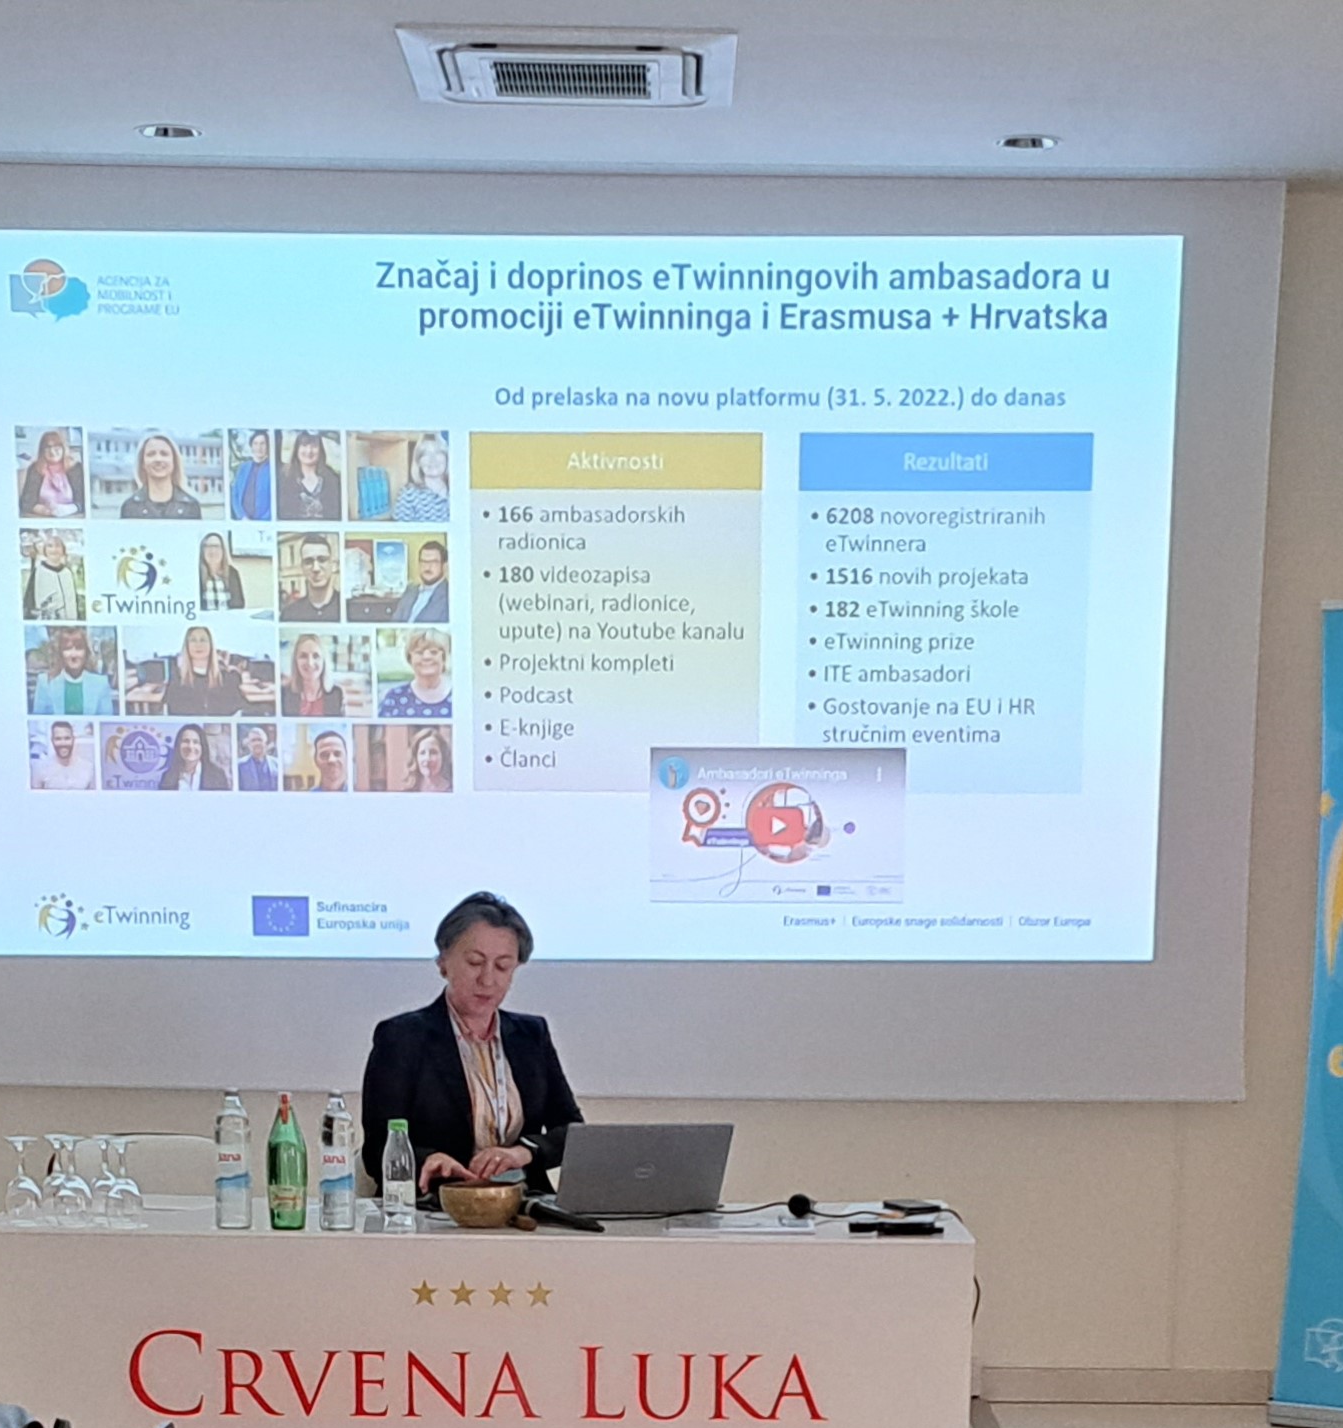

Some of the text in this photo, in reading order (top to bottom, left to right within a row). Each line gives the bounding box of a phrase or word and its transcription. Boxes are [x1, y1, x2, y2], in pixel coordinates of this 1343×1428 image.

[155, 276, 170, 287] ZA
[375, 259, 1109, 298] Značaj i doprinos eTwinningovih ambasadora u
[165, 304, 180, 315] EU
[419, 302, 1108, 337] promociji eTwinninga i Erasmusa + Hrvatska
[494, 386, 1067, 413] Od prelaska na novu platformu (31. 5. 2022.) do danas
[567, 452, 664, 471] Aktivnosti
[904, 452, 988, 471] Rezultati
[498, 506, 685, 523] 166 ambasadorskih
[826, 507, 1045, 528] 6208 novoregistriranih
[498, 533, 586, 550] radionica
[825, 535, 926, 553] eTwinnera
[499, 566, 651, 587] 180 videozapisa
[825, 568, 1029, 588] 1516 novih projekata
[92, 594, 196, 620] eTwinning
[499, 593, 696, 614] (webinari, radionice,
[825, 599, 1019, 622] 182 eTwinning škole
[500, 622, 744, 643] upute) na Youtube kanalu
[824, 633, 975, 654] eTwinning prize
[500, 654, 674, 674] Projektni kompleti
[824, 665, 970, 683] ITE ambasadori
[500, 687, 573, 704] Podcast
[823, 698, 930, 719] Gostovanje
[937, 702, 958, 716] na
[966, 698, 992, 715] EU
[1009, 698, 1035, 716] HR
[500, 719, 574, 740] E-knjige
[823, 725, 1000, 743] stručnim eventima
[500, 750, 557, 768] Članci
[94, 904, 191, 929] eTwinning
[316, 901, 388, 914] Sufinancira
[316, 918, 410, 932] Europska unija
[129, 1328, 828, 1421] CRVENA LUKA
